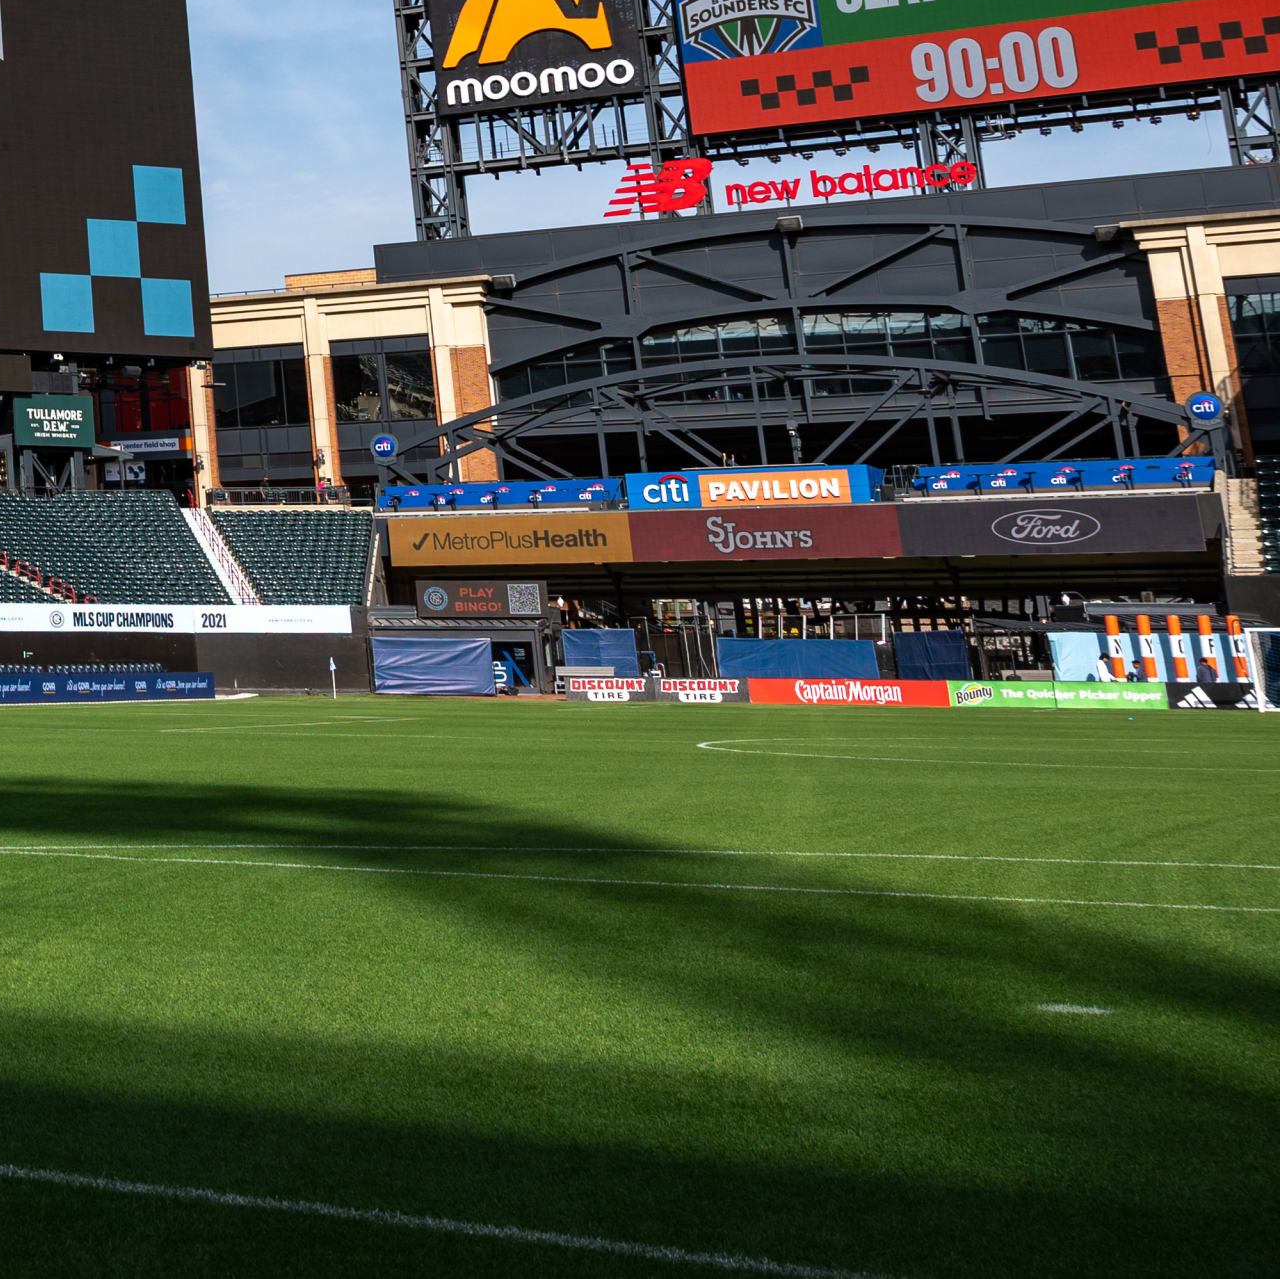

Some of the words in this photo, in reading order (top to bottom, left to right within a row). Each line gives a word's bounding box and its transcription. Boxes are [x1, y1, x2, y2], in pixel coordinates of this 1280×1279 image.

[784, 0, 806, 14] FC
[910, 26, 1080, 103] 90:00
[446, 59, 635, 106] moomoo
[726, 176, 801, 206] new
[810, 160, 978, 199] balance
[26, 408, 83, 421] TULLAMORE
[1192, 402, 1214, 413] citi
[143, 440, 159, 448] field
[159, 441, 176, 449] shop
[375, 441, 391, 452] citi
[643, 476, 689, 503] citi
[708, 478, 840, 501] PAVILION
[1011, 514, 1081, 539] Ford
[433, 528, 607, 551] MetroPlusHealth
[458, 588, 494, 598] PLAY
[454, 601, 502, 612] BINGO!
[73, 612, 95, 627] MLS
[95, 612, 115, 627] CUP
[116, 612, 174, 628] CHAMPIONS
[201, 613, 227, 629] 2021
[570, 678, 646, 692] DISCOUNT
[660, 679, 739, 693] DISCOUNT
[795, 679, 848, 703] Captain
[847, 680, 903, 705] Morgan
[592, 692, 625, 701] TIRE
[684, 692, 718, 702] TIRE
[956, 685, 993, 704] Bounty
[1000, 688, 1023, 698] The
[1027, 689, 1075, 700] Quicker
[1078, 690, 1119, 701] Picker
[1123, 691, 1163, 703] Upper
